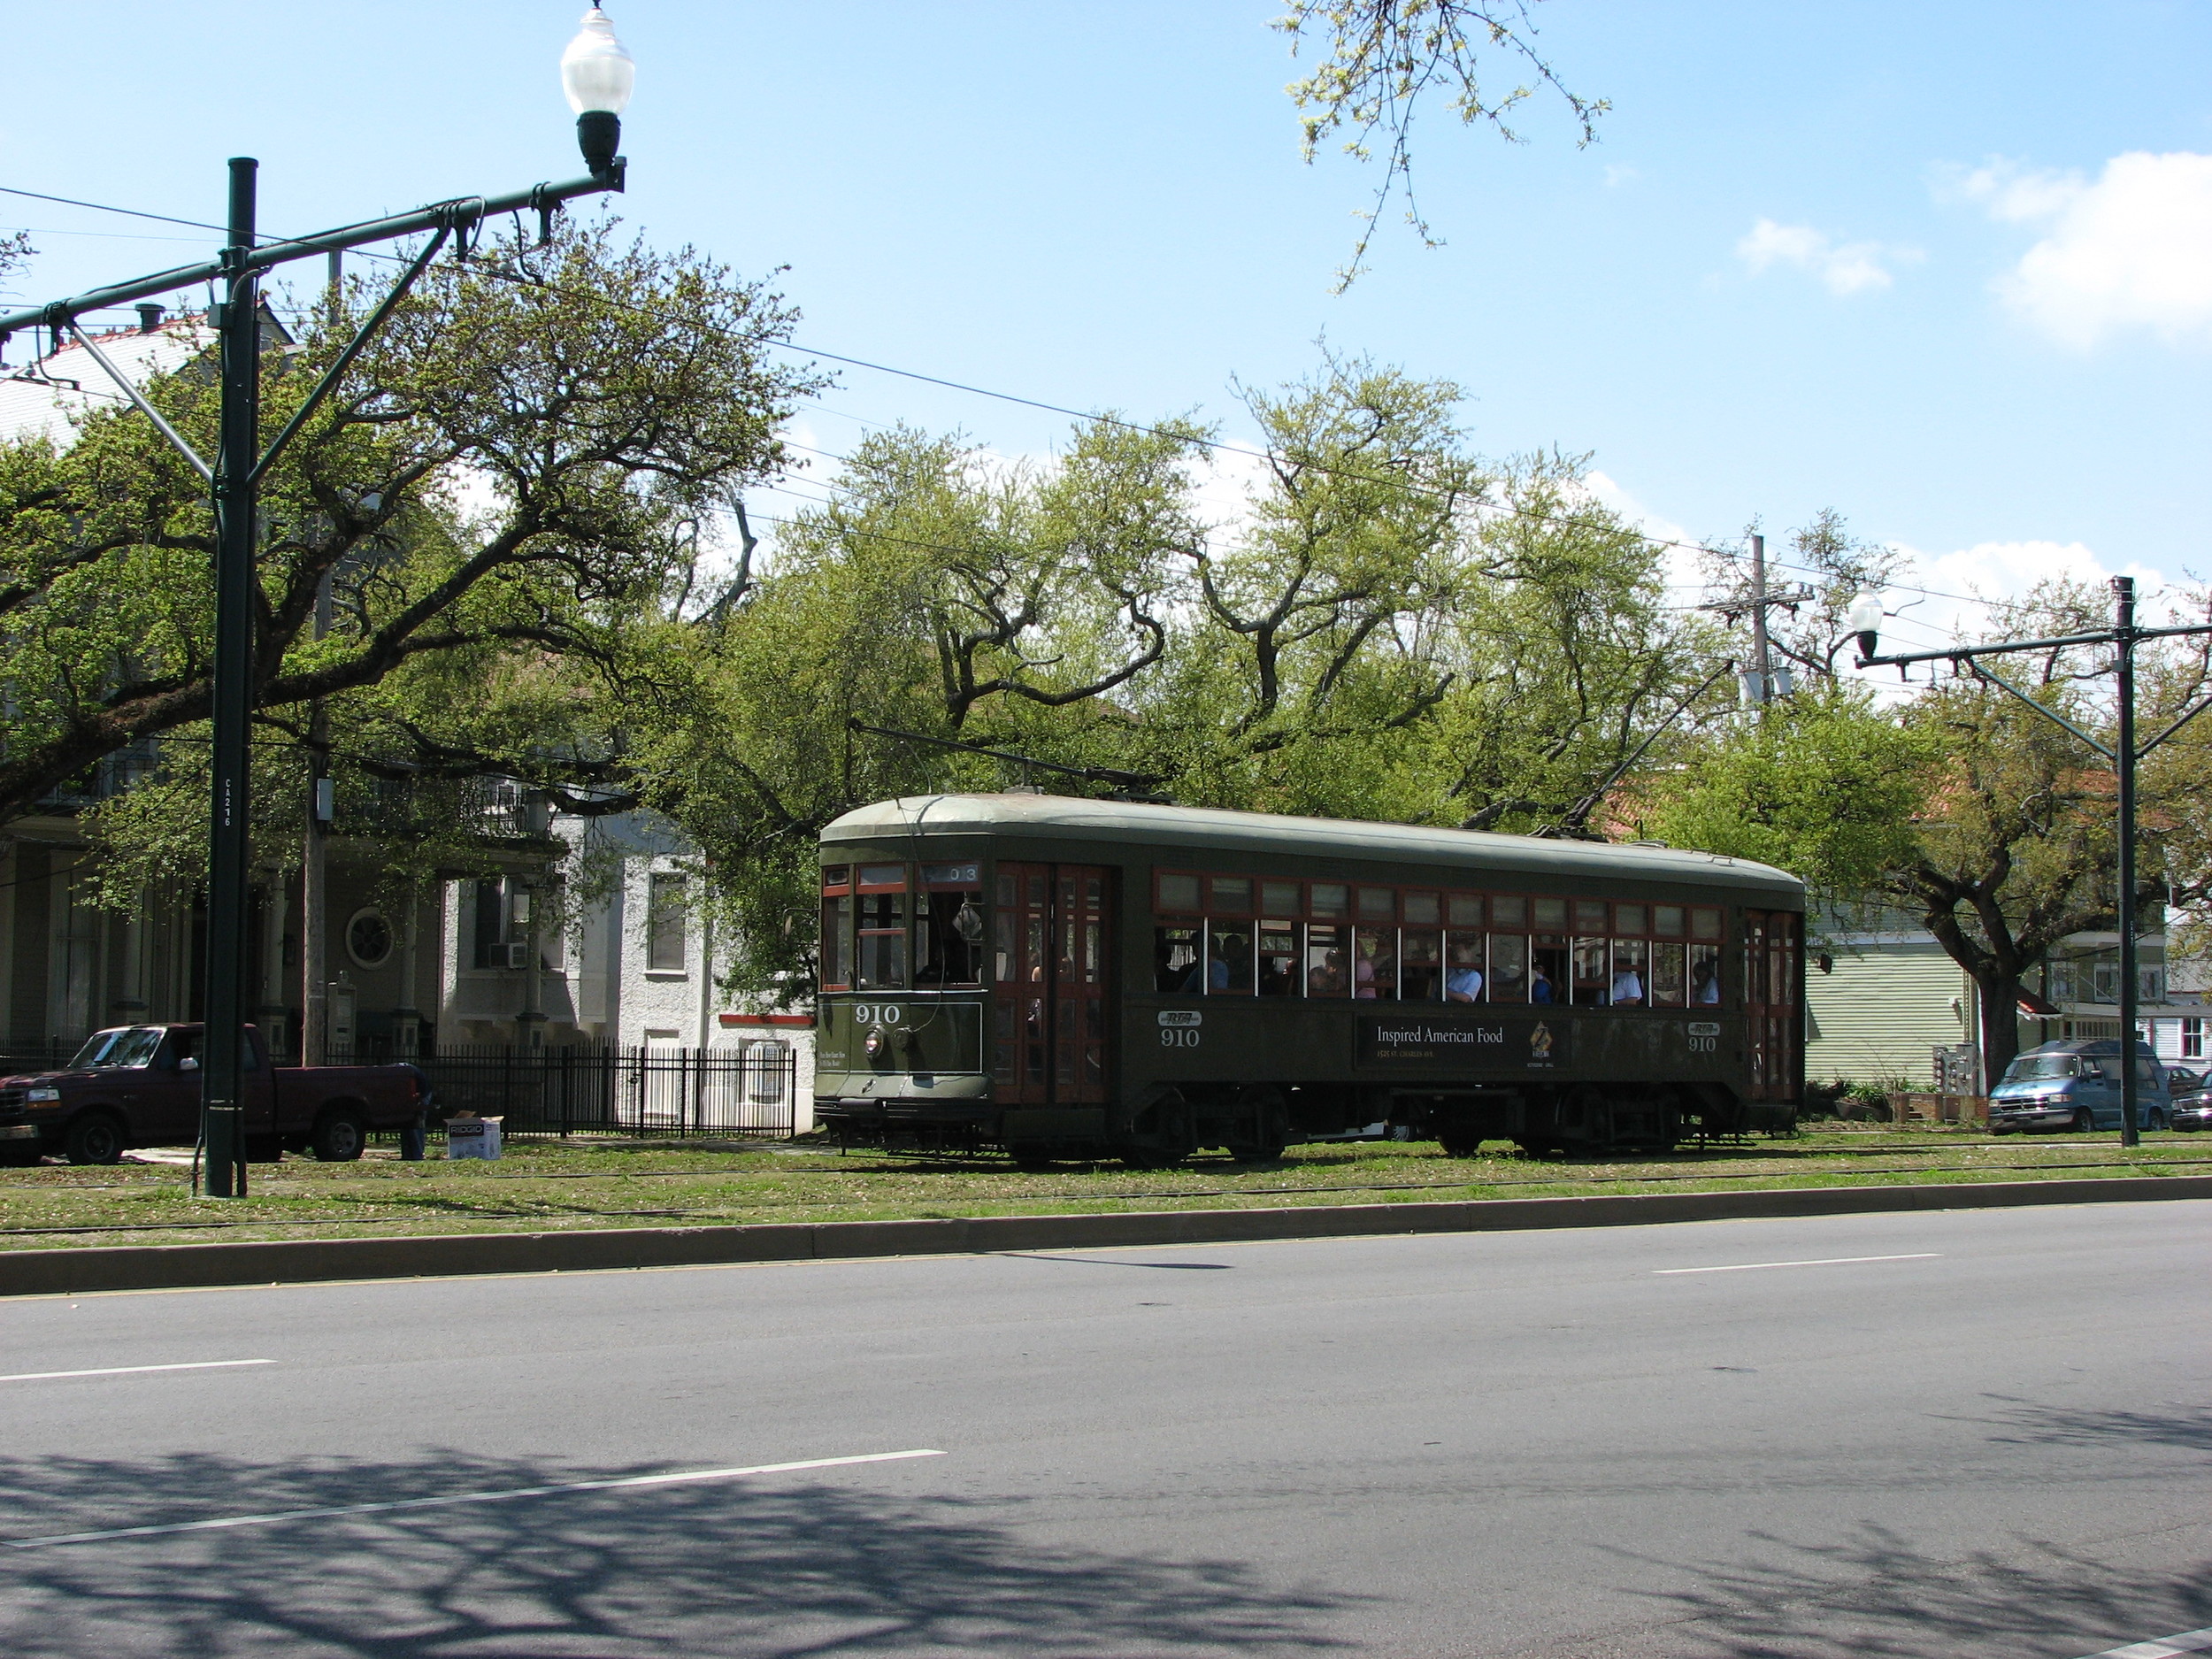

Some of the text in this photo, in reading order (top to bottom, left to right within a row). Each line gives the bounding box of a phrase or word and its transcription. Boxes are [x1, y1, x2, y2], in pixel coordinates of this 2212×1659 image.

[856, 1005, 901, 1024] 910
[1161, 1029, 1200, 1048] 910
[1377, 1025, 1503, 1047] Inspired American Food
[1688, 1037, 1717, 1052] 910
[450, 1125, 483, 1133] RIDGID
